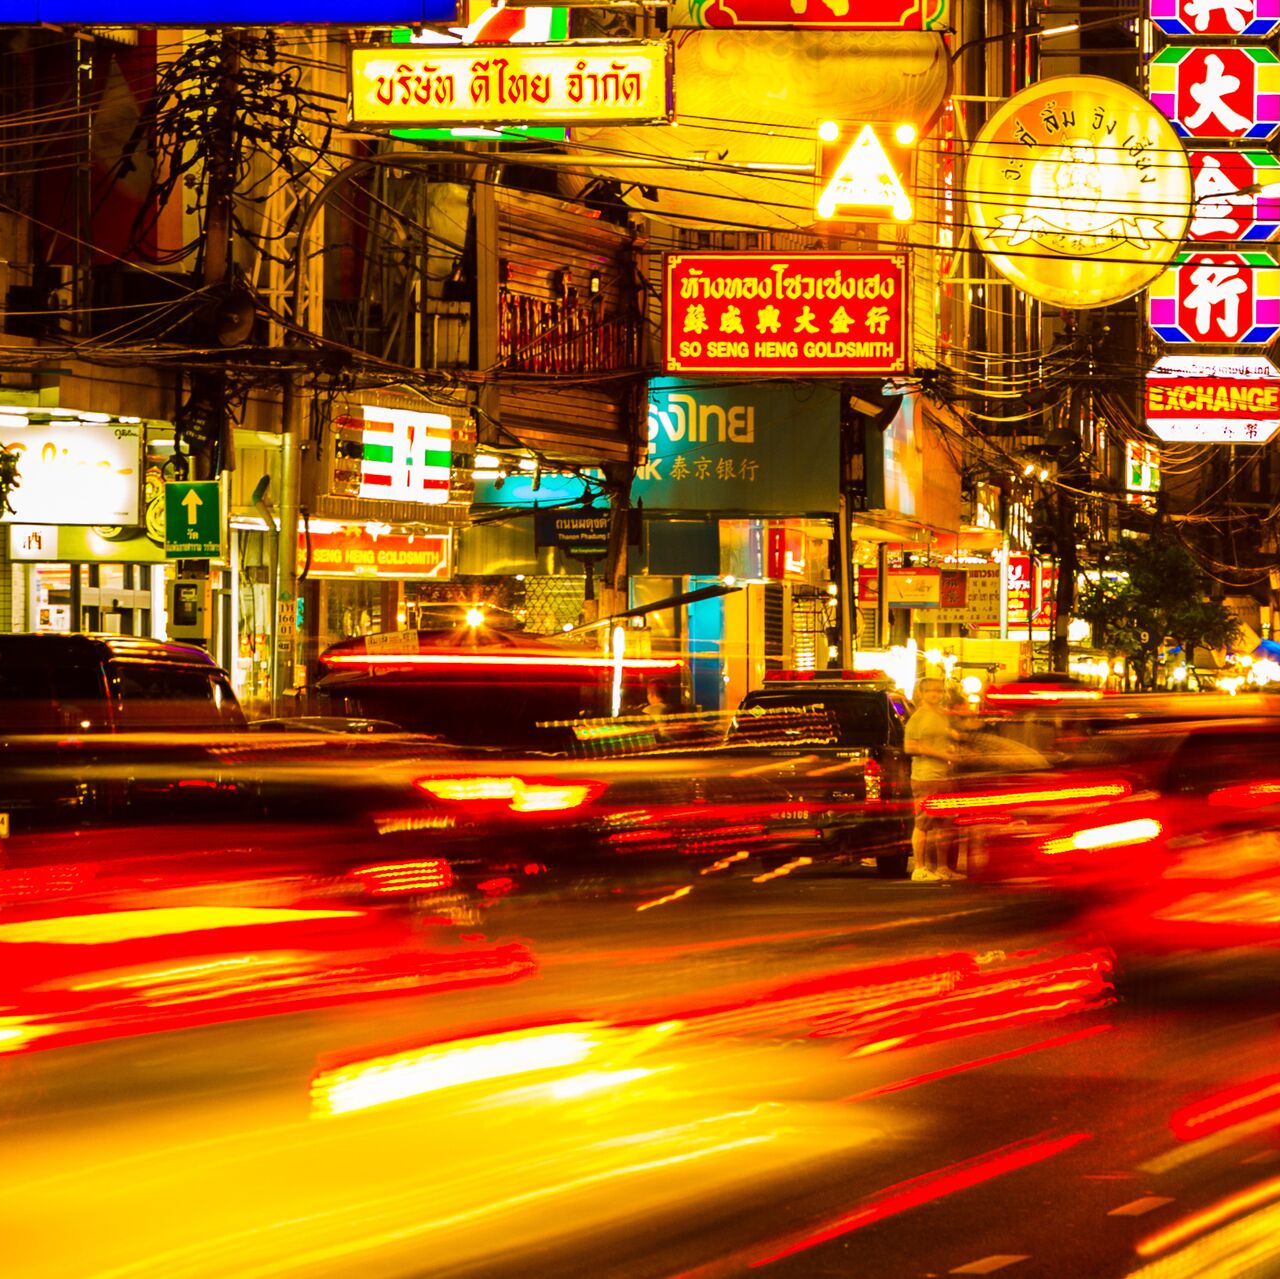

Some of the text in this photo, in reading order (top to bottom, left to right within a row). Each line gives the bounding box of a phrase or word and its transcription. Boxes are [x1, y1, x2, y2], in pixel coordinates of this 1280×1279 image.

[377, 58, 642, 106] บริษัท ดีไทย จำกัด
[683, 305, 891, 335] 蘇成興大金行
[679, 339, 895, 360] SO SENG HENG GOLDSMITH
[1149, 385, 1280, 413] EXCHANGE
[670, 455, 761, 482] 泰京银行
[555, 511, 611, 533] ถนนผดุงด้
[313, 549, 342, 563] SENG
[345, 549, 375, 564] HENG
[377, 550, 440, 565] GOLDSMITH
